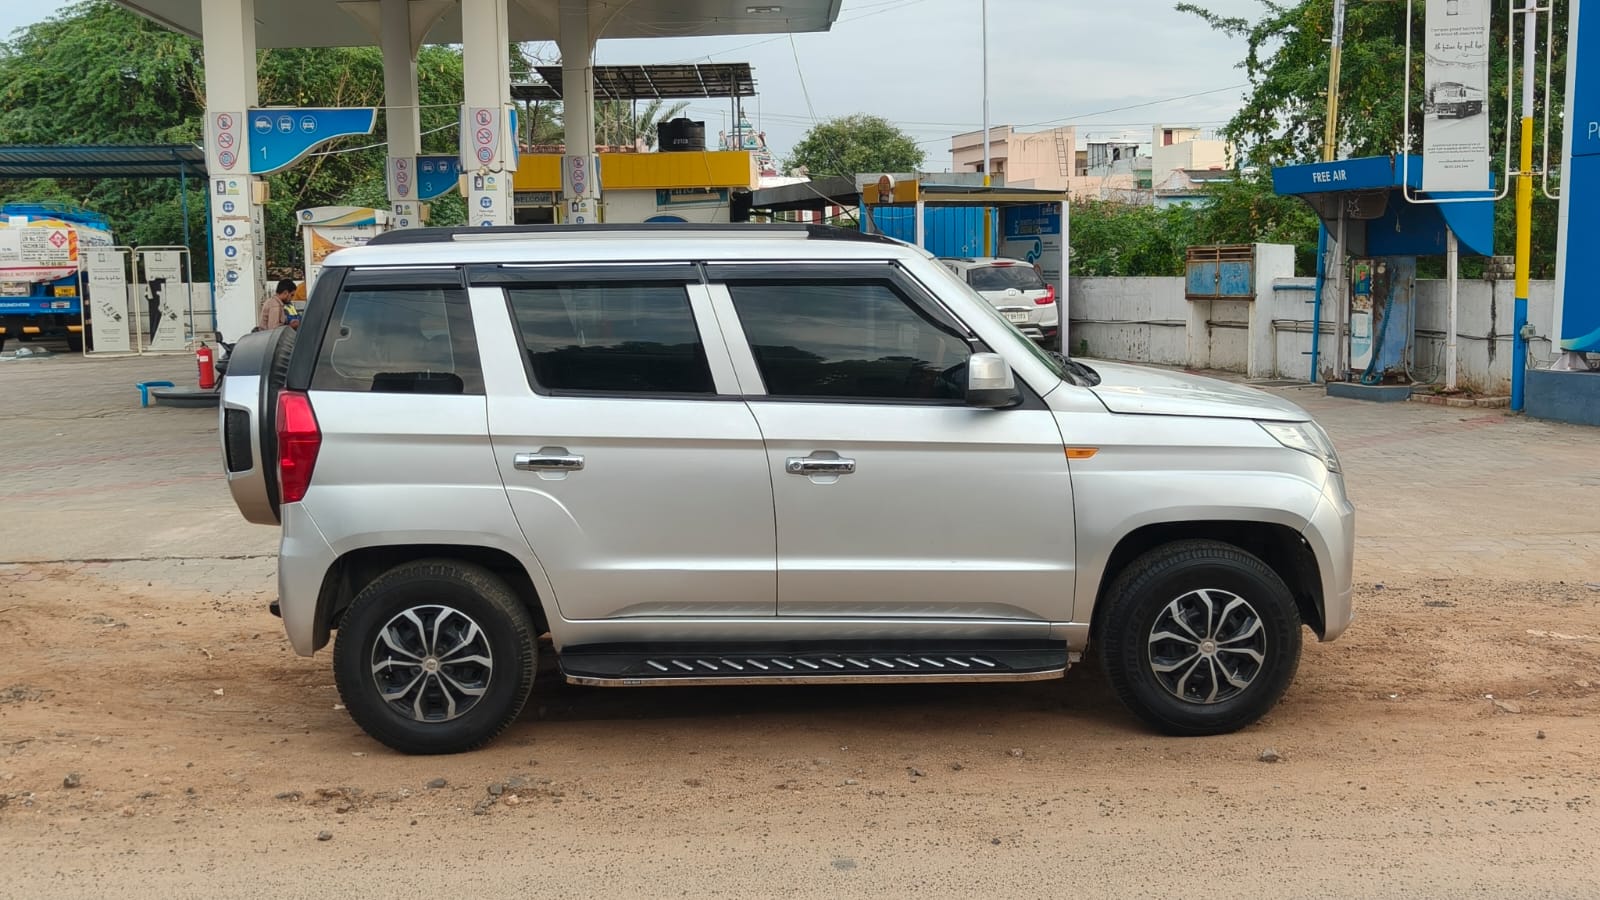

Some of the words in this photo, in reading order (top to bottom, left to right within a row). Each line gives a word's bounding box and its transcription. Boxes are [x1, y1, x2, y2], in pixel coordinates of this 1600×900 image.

[260, 146, 268, 160] 1
[1312, 171, 1331, 183] FREE
[1332, 169, 1347, 181] AIR
[425, 182, 433, 192] 3
